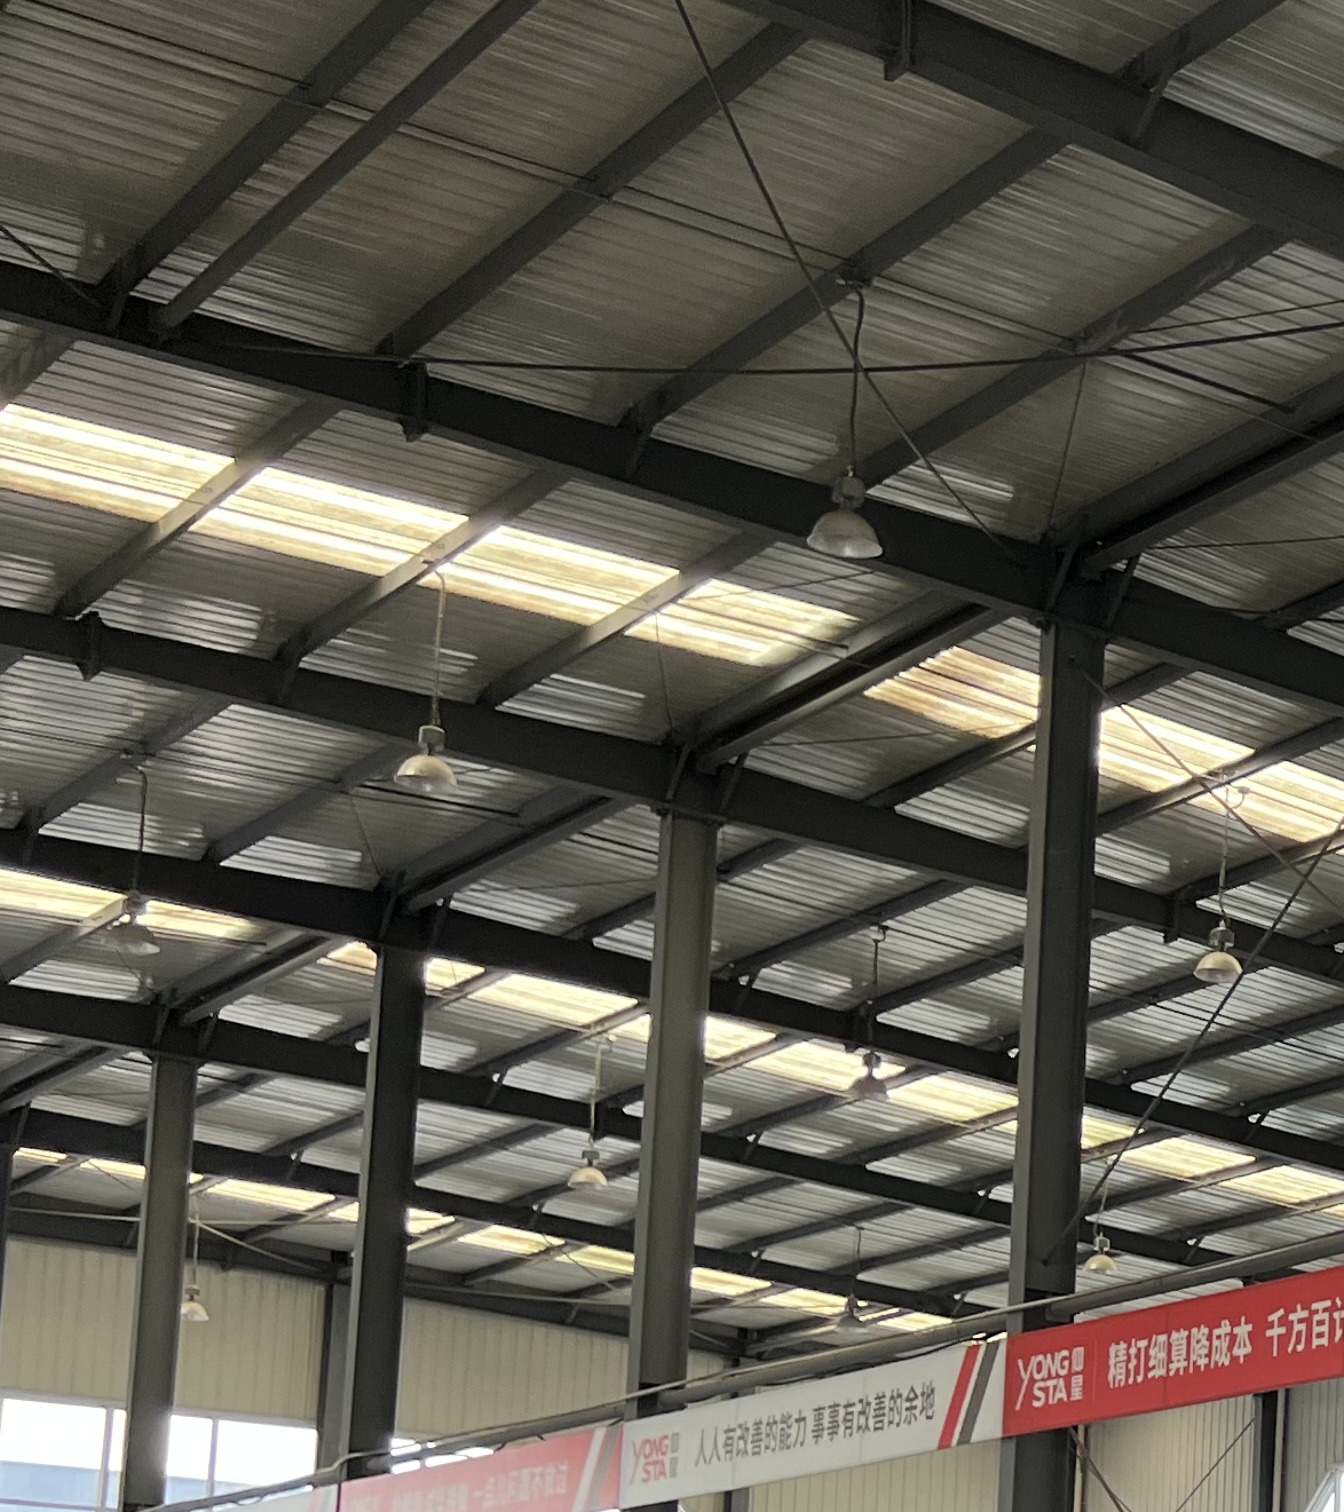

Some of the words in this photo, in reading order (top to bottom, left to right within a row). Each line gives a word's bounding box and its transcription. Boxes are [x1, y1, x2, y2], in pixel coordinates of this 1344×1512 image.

[1016, 1347, 1070, 1411] YONG
[1071, 1347, 1084, 1401] 仰星
[1107, 1316, 1253, 1389] 精打细算降成本
[1032, 1379, 1068, 1408] STA
[695, 1408, 807, 1467] 人人有改善的能力
[811, 1380, 935, 1445] 事事有改善的余地
[631, 1433, 670, 1485] YONG
[642, 1457, 668, 1483] STA
